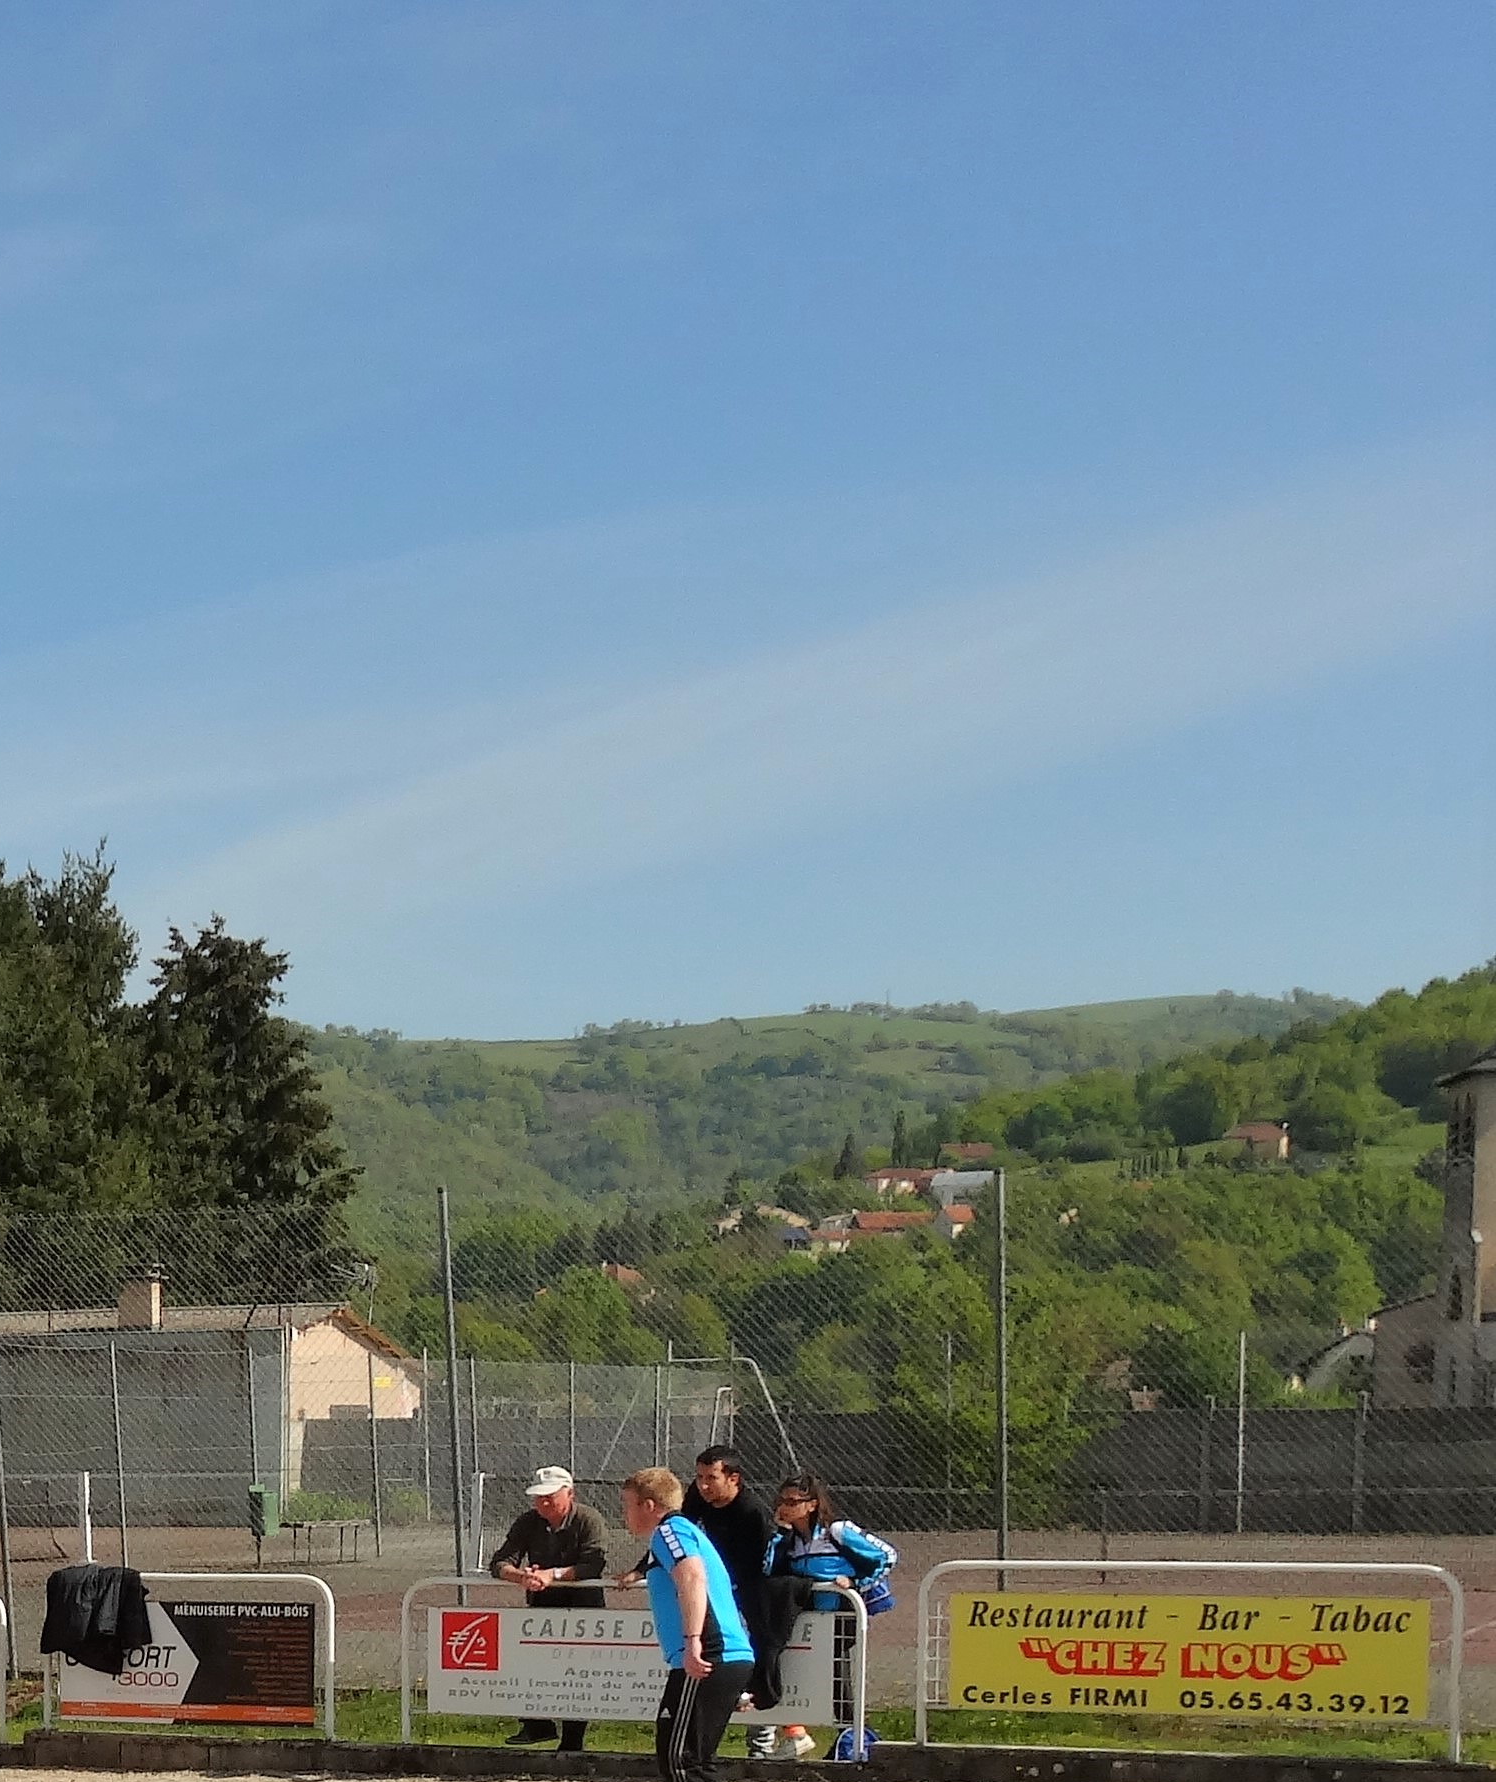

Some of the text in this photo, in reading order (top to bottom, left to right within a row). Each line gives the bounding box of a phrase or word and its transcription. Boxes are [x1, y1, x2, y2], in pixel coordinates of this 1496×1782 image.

[967, 1600, 1148, 1630] Restaurant
[1197, 1603, 1261, 1632] Bar
[1310, 1603, 1412, 1634] Tabac
[521, 1617, 625, 1639] CAISSE
[118, 1671, 179, 1688] 3000
[564, 1667, 637, 1679] Agence
[460, 1676, 520, 1688] Accueil
[601, 1680, 623, 1690] du
[448, 1689, 481, 1699] RDV
[600, 1692, 621, 1702] du
[962, 1685, 1411, 1715] Cerles FIRMI 05.65.43.39.12
